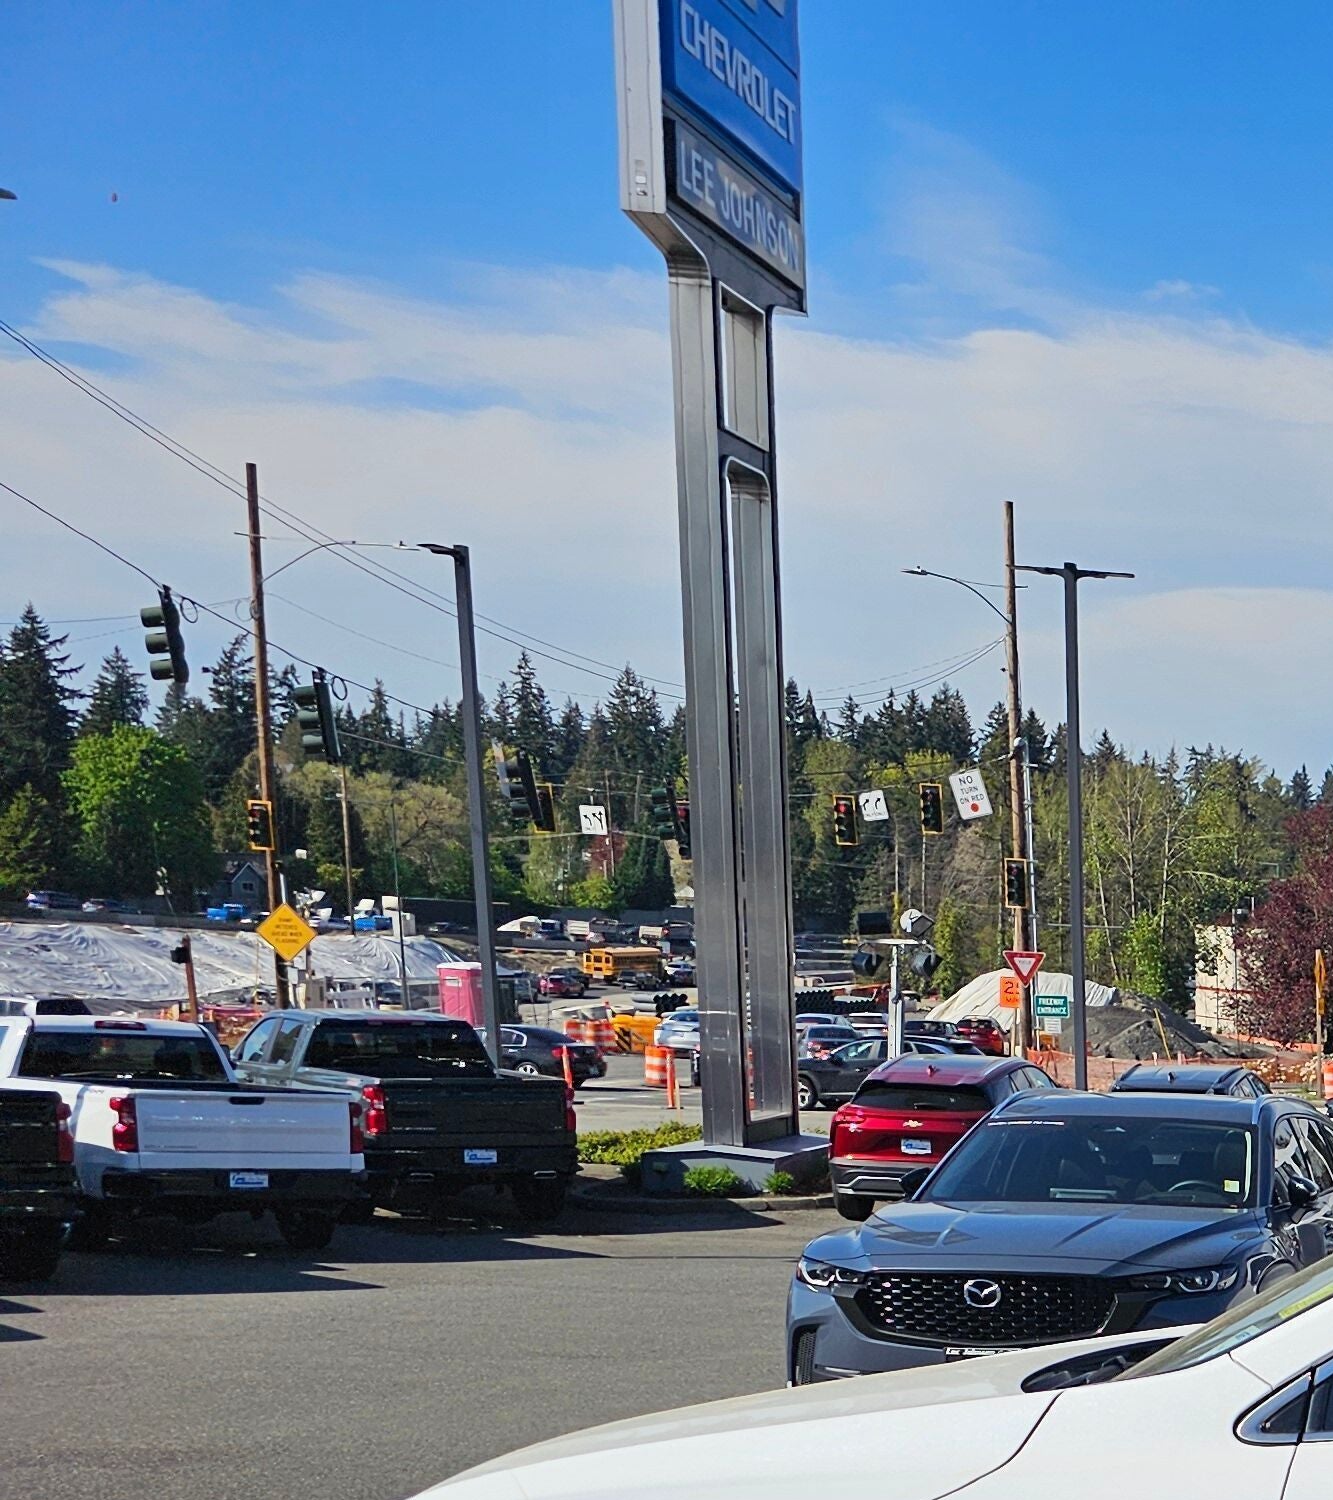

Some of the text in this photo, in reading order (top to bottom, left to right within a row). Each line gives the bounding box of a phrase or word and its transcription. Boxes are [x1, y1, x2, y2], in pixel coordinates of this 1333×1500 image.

[681, 2, 796, 145] CHEVROLET
[681, 140, 799, 272] LEE JOHNSON
[959, 775, 973, 785] NO
[960, 786, 978, 795] TURN
[971, 793, 985, 801] RED
